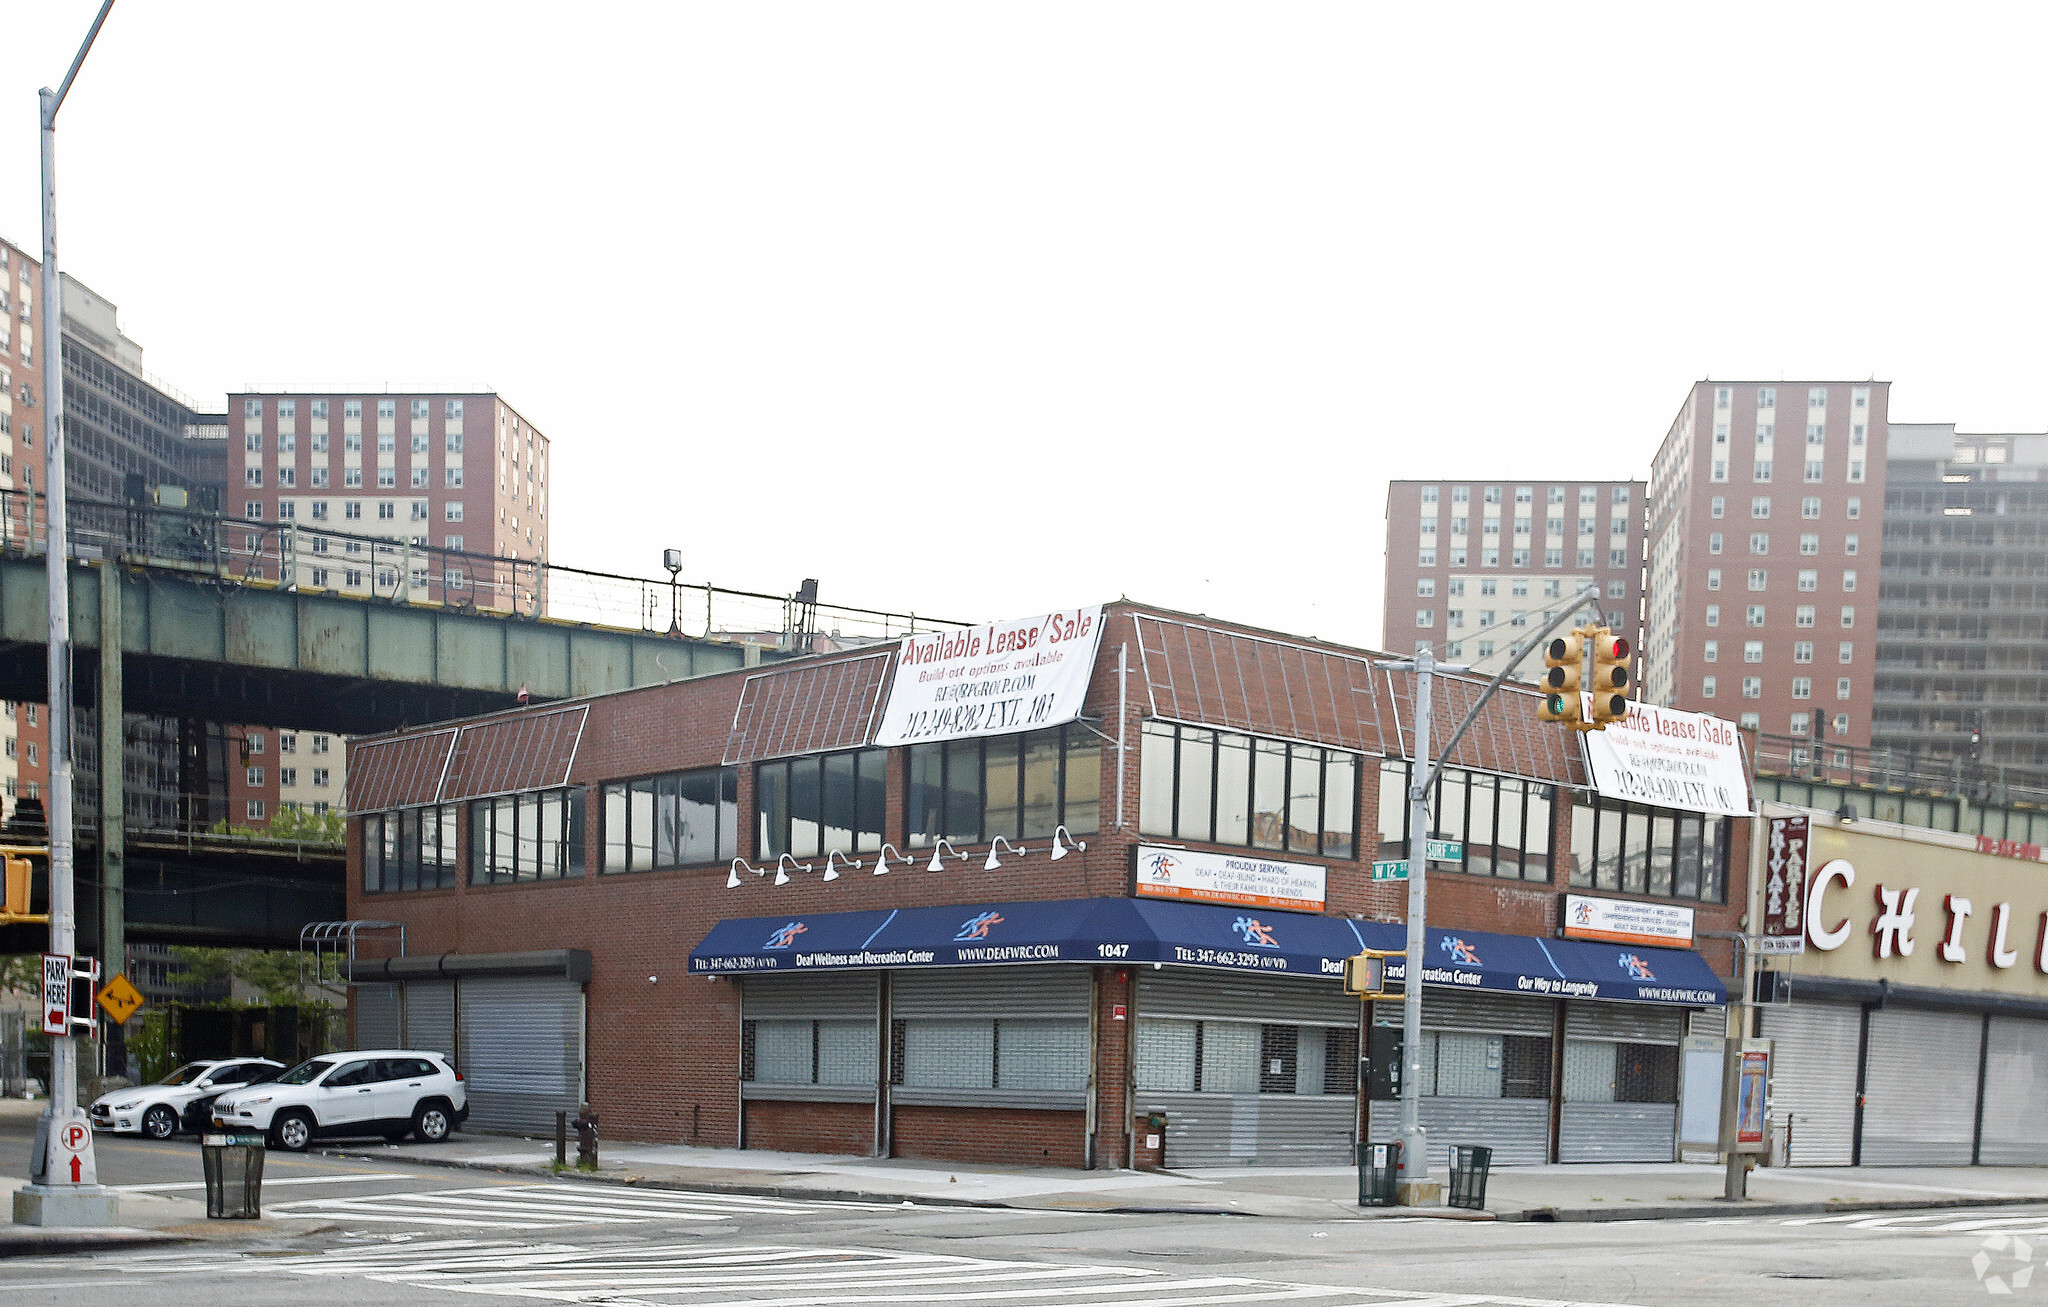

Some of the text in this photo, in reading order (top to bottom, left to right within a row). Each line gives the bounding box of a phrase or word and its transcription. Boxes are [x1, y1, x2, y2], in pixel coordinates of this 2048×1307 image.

[902, 629, 980, 666] Available
[969, 662, 1009, 680] options
[1013, 649, 1064, 670] available
[1026, 692, 1055, 724] 103
[1427, 842, 1446, 858] SURF
[1225, 859, 1257, 871] PROUDLY
[1375, 865, 1384, 878] W
[1387, 864, 1396, 878] 12
[1767, 819, 1787, 915] PRIVATE
[1194, 868, 1212, 877] DEAF
[1262, 875, 1280, 885] HARD
[1281, 877, 1289, 885] OF
[1290, 878, 1317, 889] HEARING
[1784, 838, 1804, 929] PARTIES
[1240, 884, 1268, 893] FAMILIES
[1277, 887, 1304, 896] FRIENDS
[795, 950, 935, 967] Deaf Wellness and Recreation Center
[957, 944, 1059, 961] WWW.DEAFWRC.COM
[1097, 944, 1130, 958] 1047
[1175, 947, 1196, 961] TEL:
[1196, 949, 1259, 968] 347-662-3295
[46, 960, 66, 982] PARK
[1321, 958, 1344, 974] Deaf
[1387, 964, 1405, 978] and
[1421, 968, 1453, 983] reation
[1453, 969, 1483, 985] Center
[46, 984, 66, 1004] HERE
[1517, 975, 1599, 998] Our Way to Longevity
[1638, 987, 1716, 1003] WWW.DEAFWRC.COM
[70, 1128, 83, 1147] P
